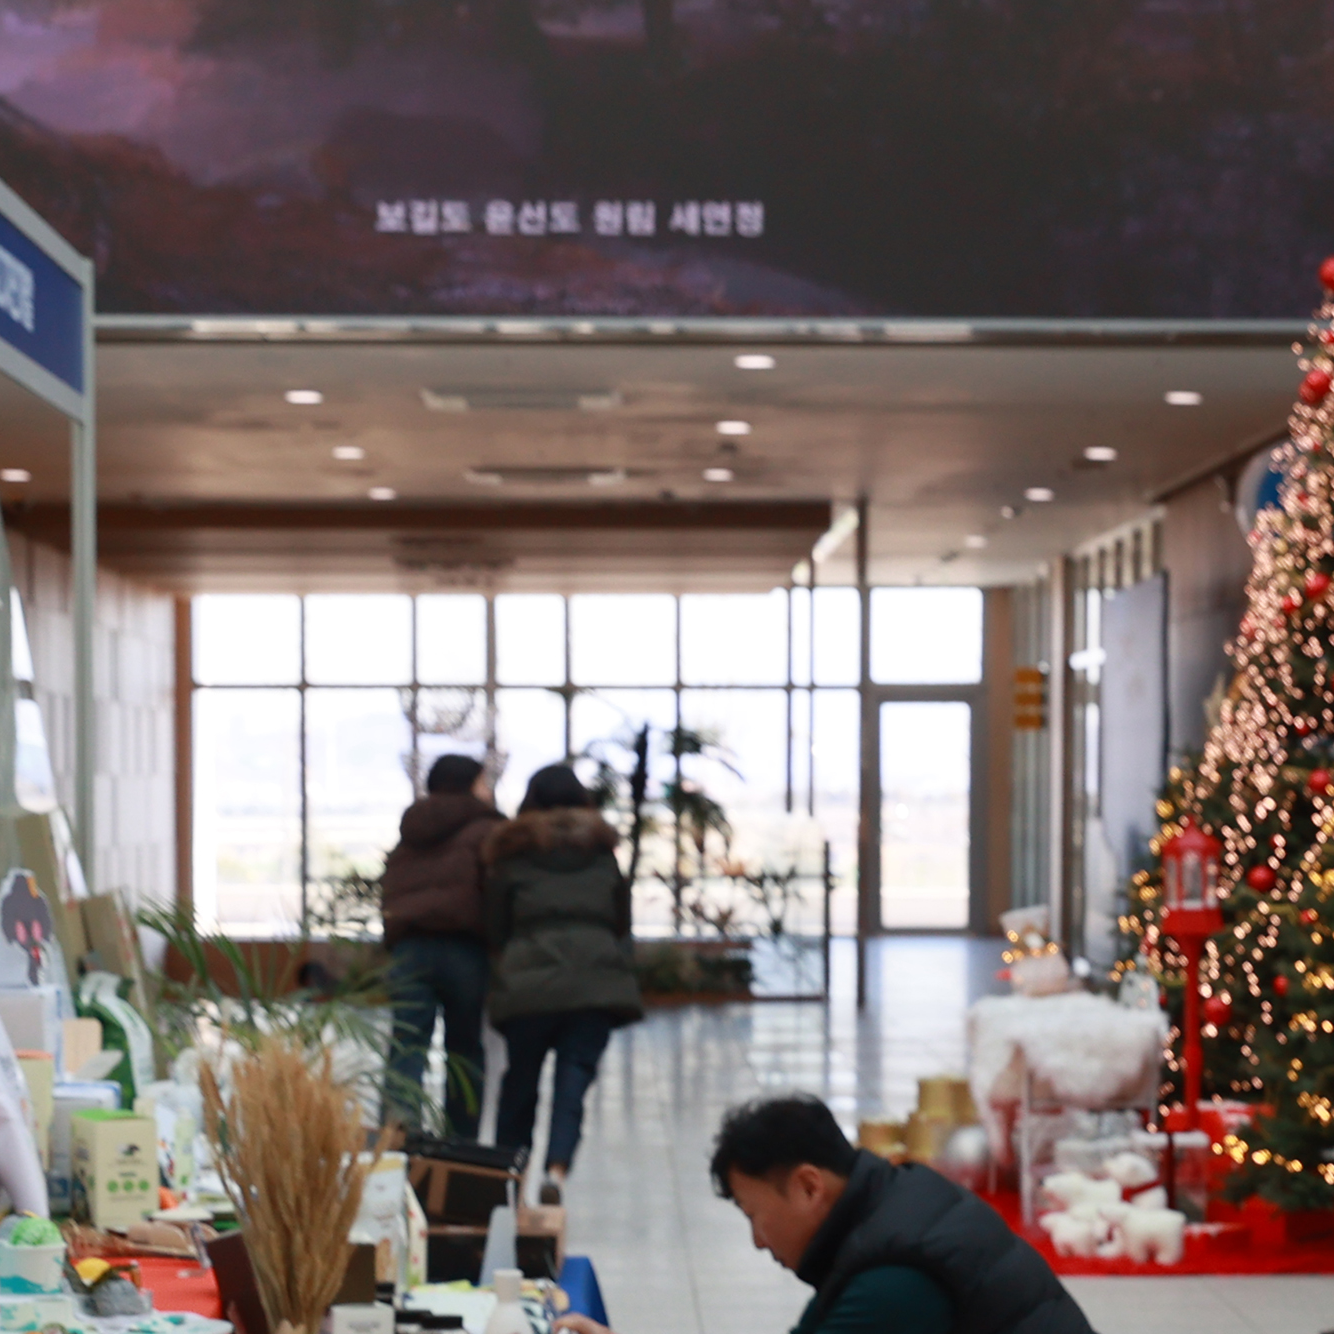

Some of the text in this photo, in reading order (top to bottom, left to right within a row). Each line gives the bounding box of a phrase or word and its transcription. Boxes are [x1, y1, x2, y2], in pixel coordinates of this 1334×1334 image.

[376, 200, 764, 236] 보길도 윤선도 원림 세연정
